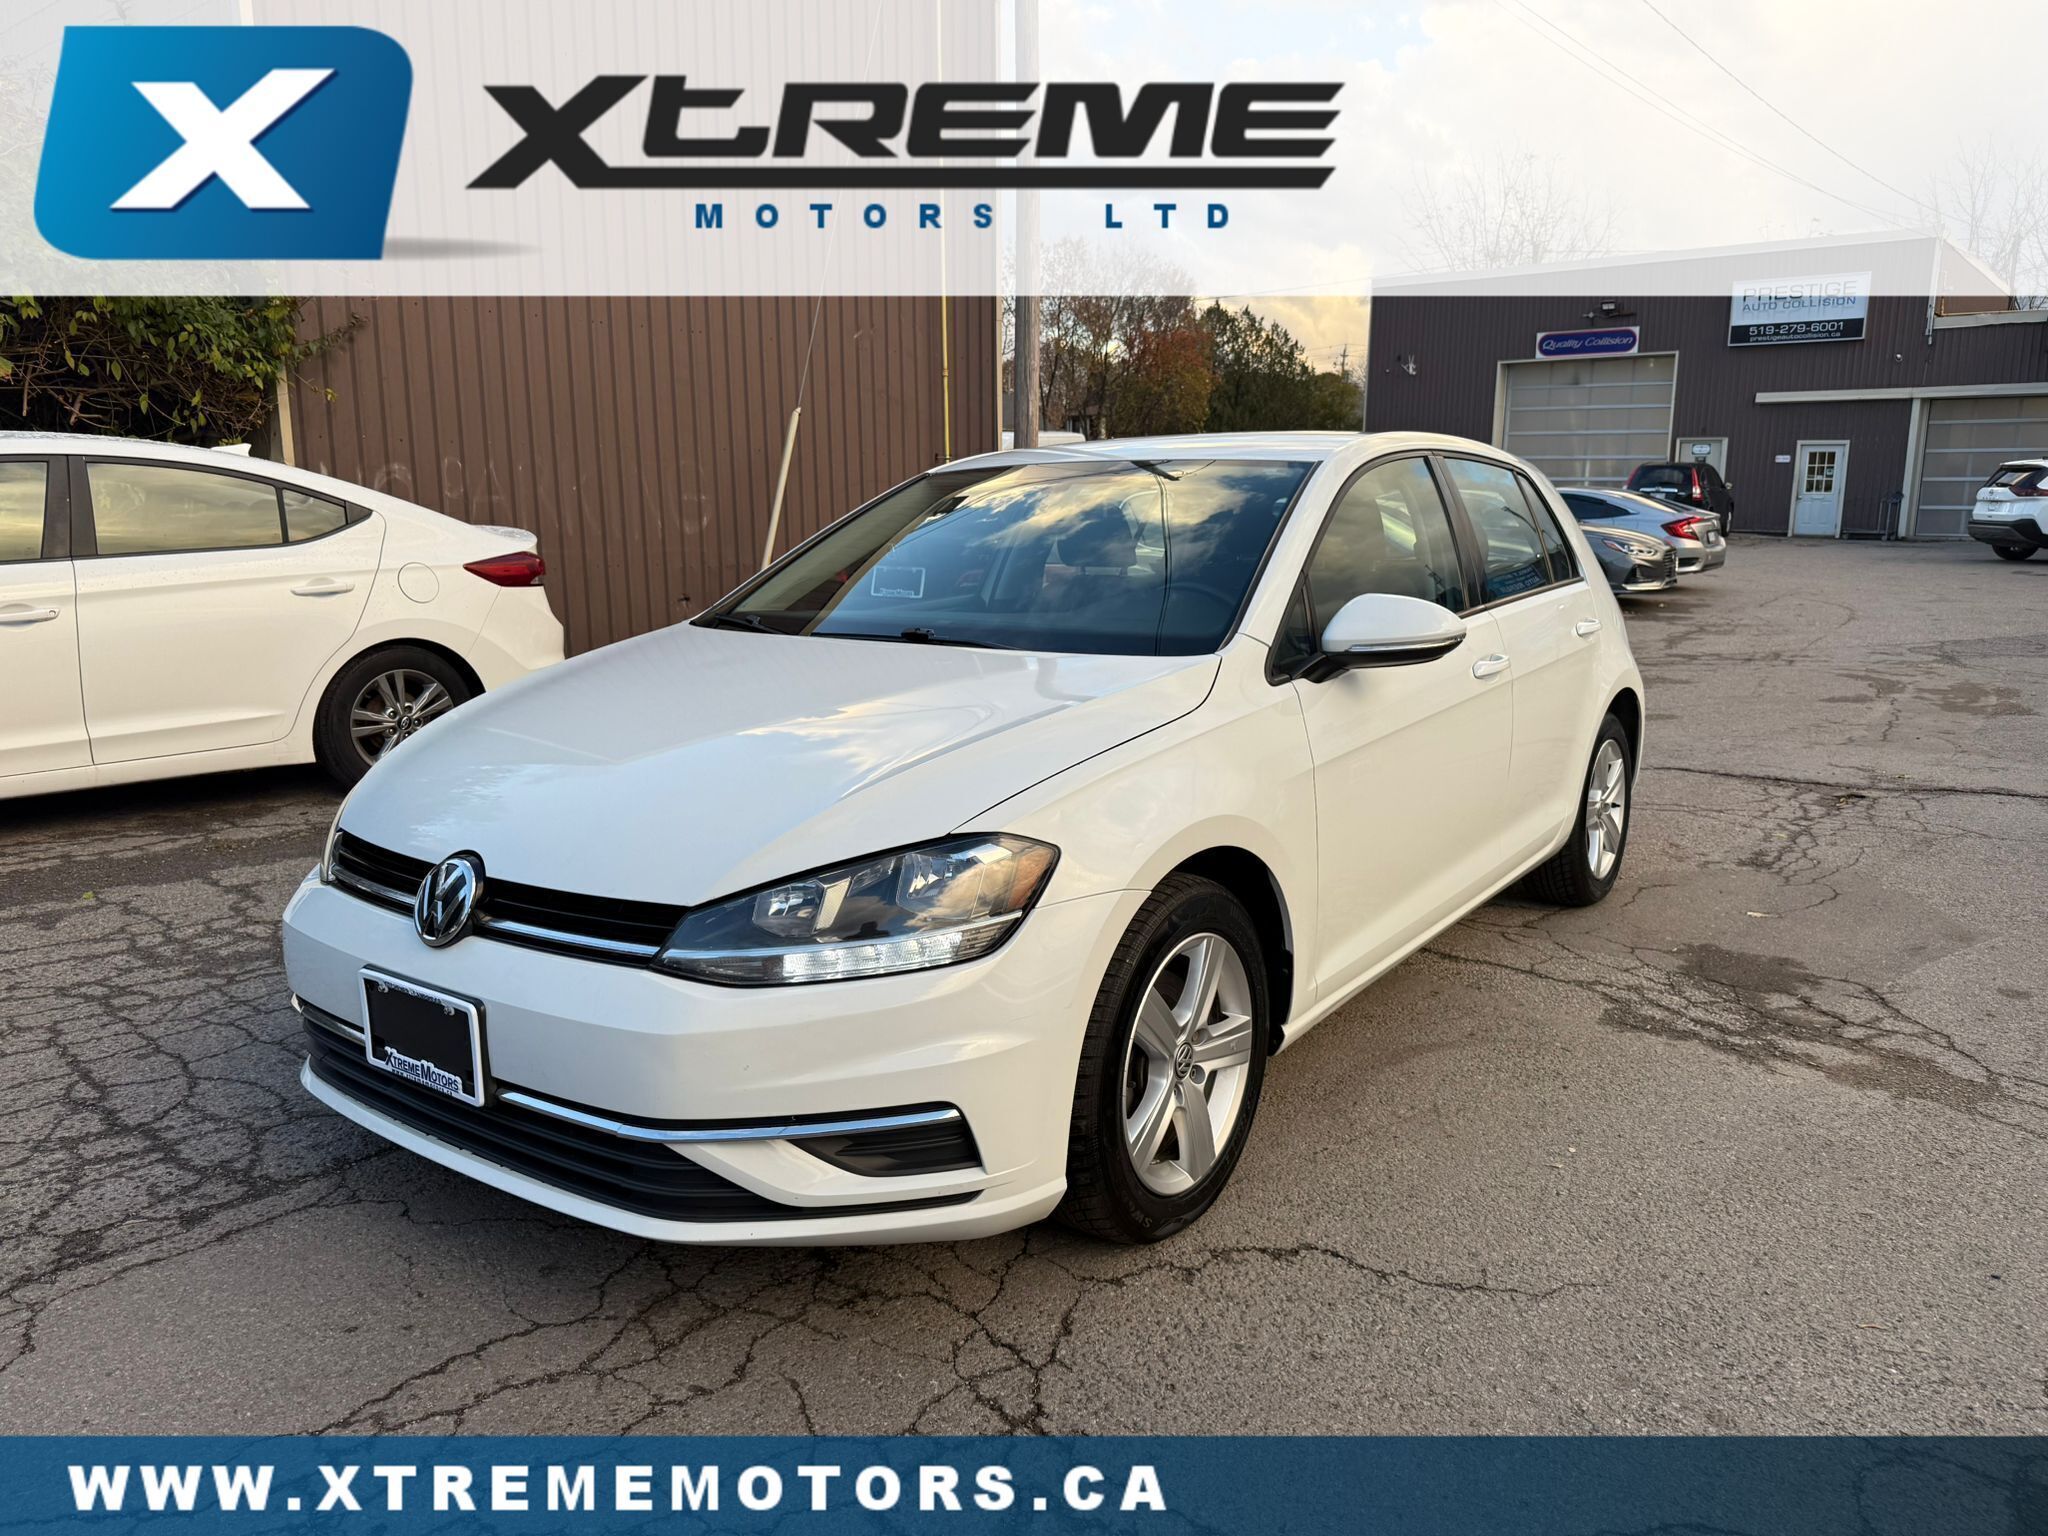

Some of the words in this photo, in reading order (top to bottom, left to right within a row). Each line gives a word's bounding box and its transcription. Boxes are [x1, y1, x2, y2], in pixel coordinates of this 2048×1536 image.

[1743, 281, 1857, 303] PRESTIGE
[1743, 302, 1778, 313] AUTO
[1782, 296, 1857, 311] COLLISION
[1749, 321, 1845, 336] 519-279-6001
[1542, 339, 1582, 351] Quality
[1584, 336, 1634, 347] Collision
